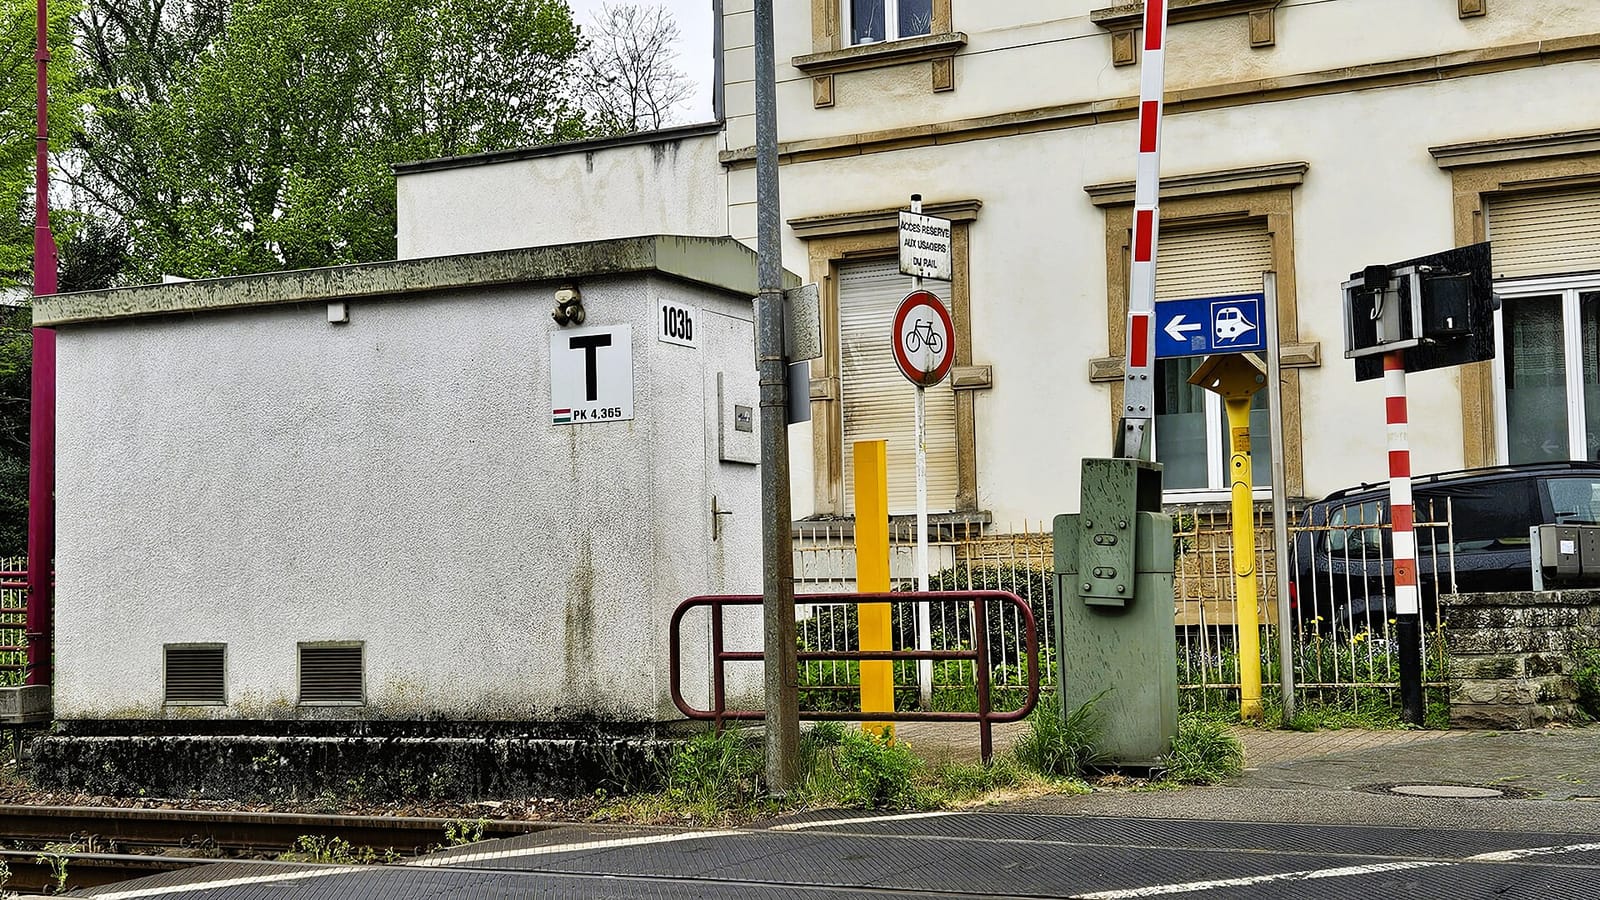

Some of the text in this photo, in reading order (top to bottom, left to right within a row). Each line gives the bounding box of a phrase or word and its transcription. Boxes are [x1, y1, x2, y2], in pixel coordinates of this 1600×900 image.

[904, 238, 946, 253] AUX USAGERS
[913, 257, 937, 268] DU RAIL
[662, 305, 693, 341] 103b
[1446, 317, 1453, 328] 1
[569, 333, 612, 402] T
[573, 409, 587, 421] PK
